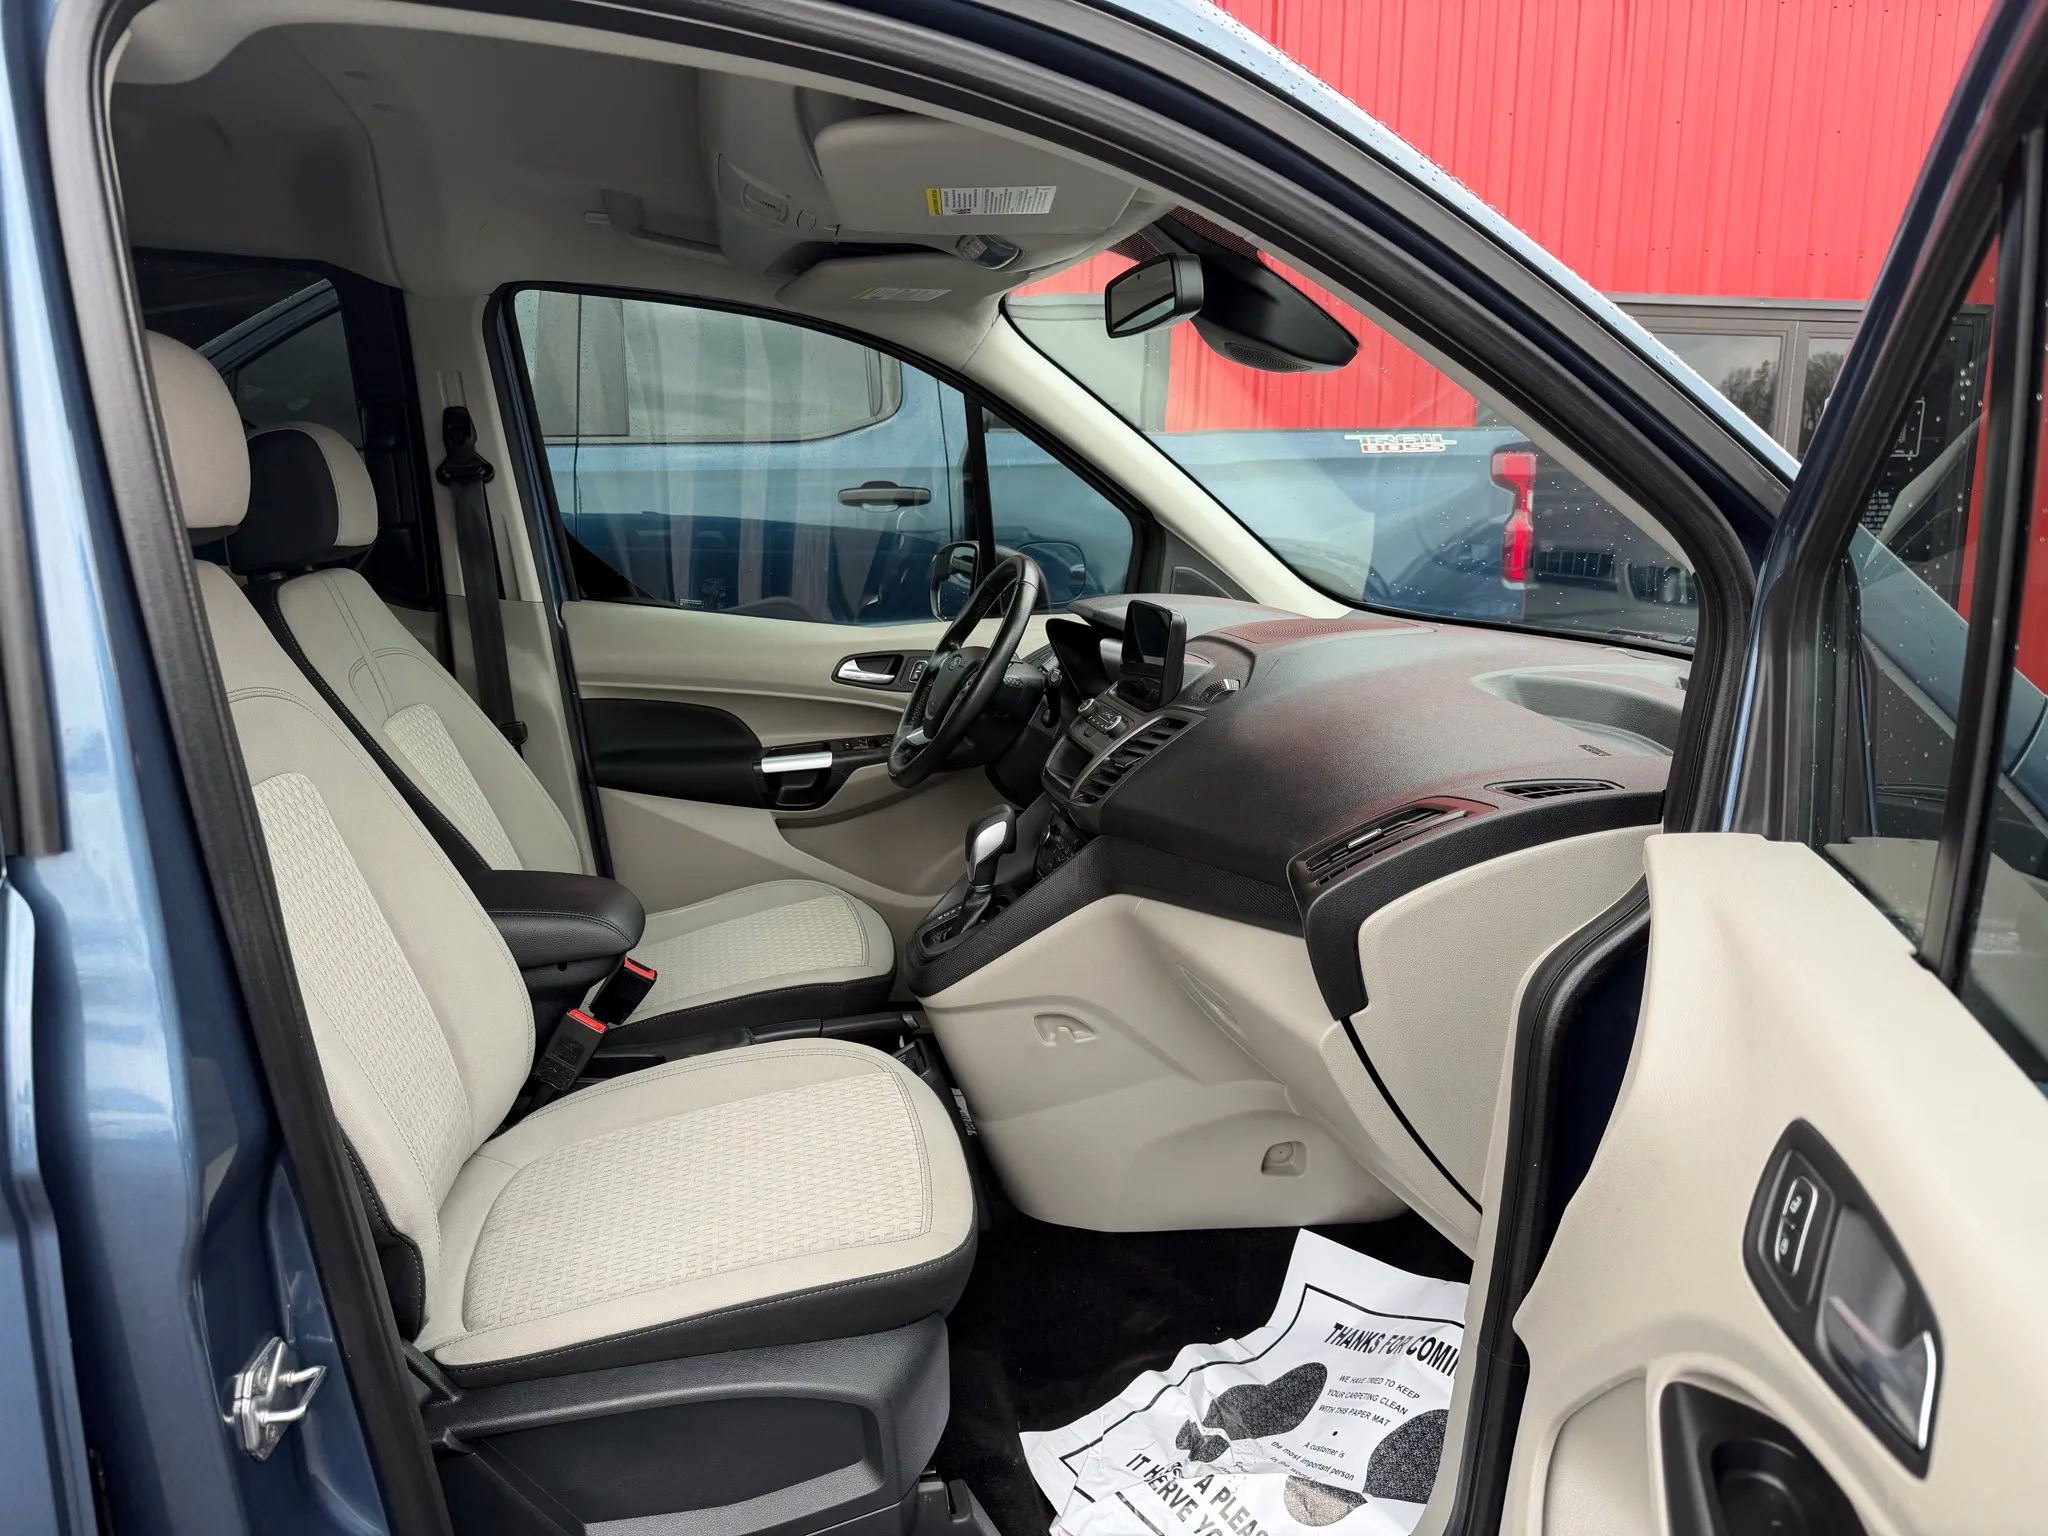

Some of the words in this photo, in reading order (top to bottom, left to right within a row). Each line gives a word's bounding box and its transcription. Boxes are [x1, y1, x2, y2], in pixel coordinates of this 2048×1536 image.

[1324, 1322, 1386, 1354] THANKS
[1378, 1335, 1414, 1355] FOR
[1339, 1375, 1350, 1383] WE
[1365, 1377, 1384, 1385] TRIED
[1384, 1378, 1396, 1388] TO
[1396, 1384, 1420, 1400] KEEP
[1327, 1388, 1346, 1399] YOUR
[1345, 1391, 1379, 1402] CARPETING
[1379, 1397, 1409, 1415] CLEAN
[1318, 1404, 1335, 1414] WITH
[1335, 1406, 1347, 1415] THIS
[1346, 1408, 1371, 1420] PAPER
[1371, 1414, 1391, 1427] MAT
[1126, 1453, 1151, 1471] IT
[1270, 1440, 1283, 1450] the
[1282, 1448, 1301, 1461] most
[1299, 1456, 1332, 1473] important
[1328, 1465, 1355, 1481] person
[1309, 1444, 1339, 1457] customer
[1338, 1448, 1346, 1459] is
[1193, 1474, 1215, 1495] A
